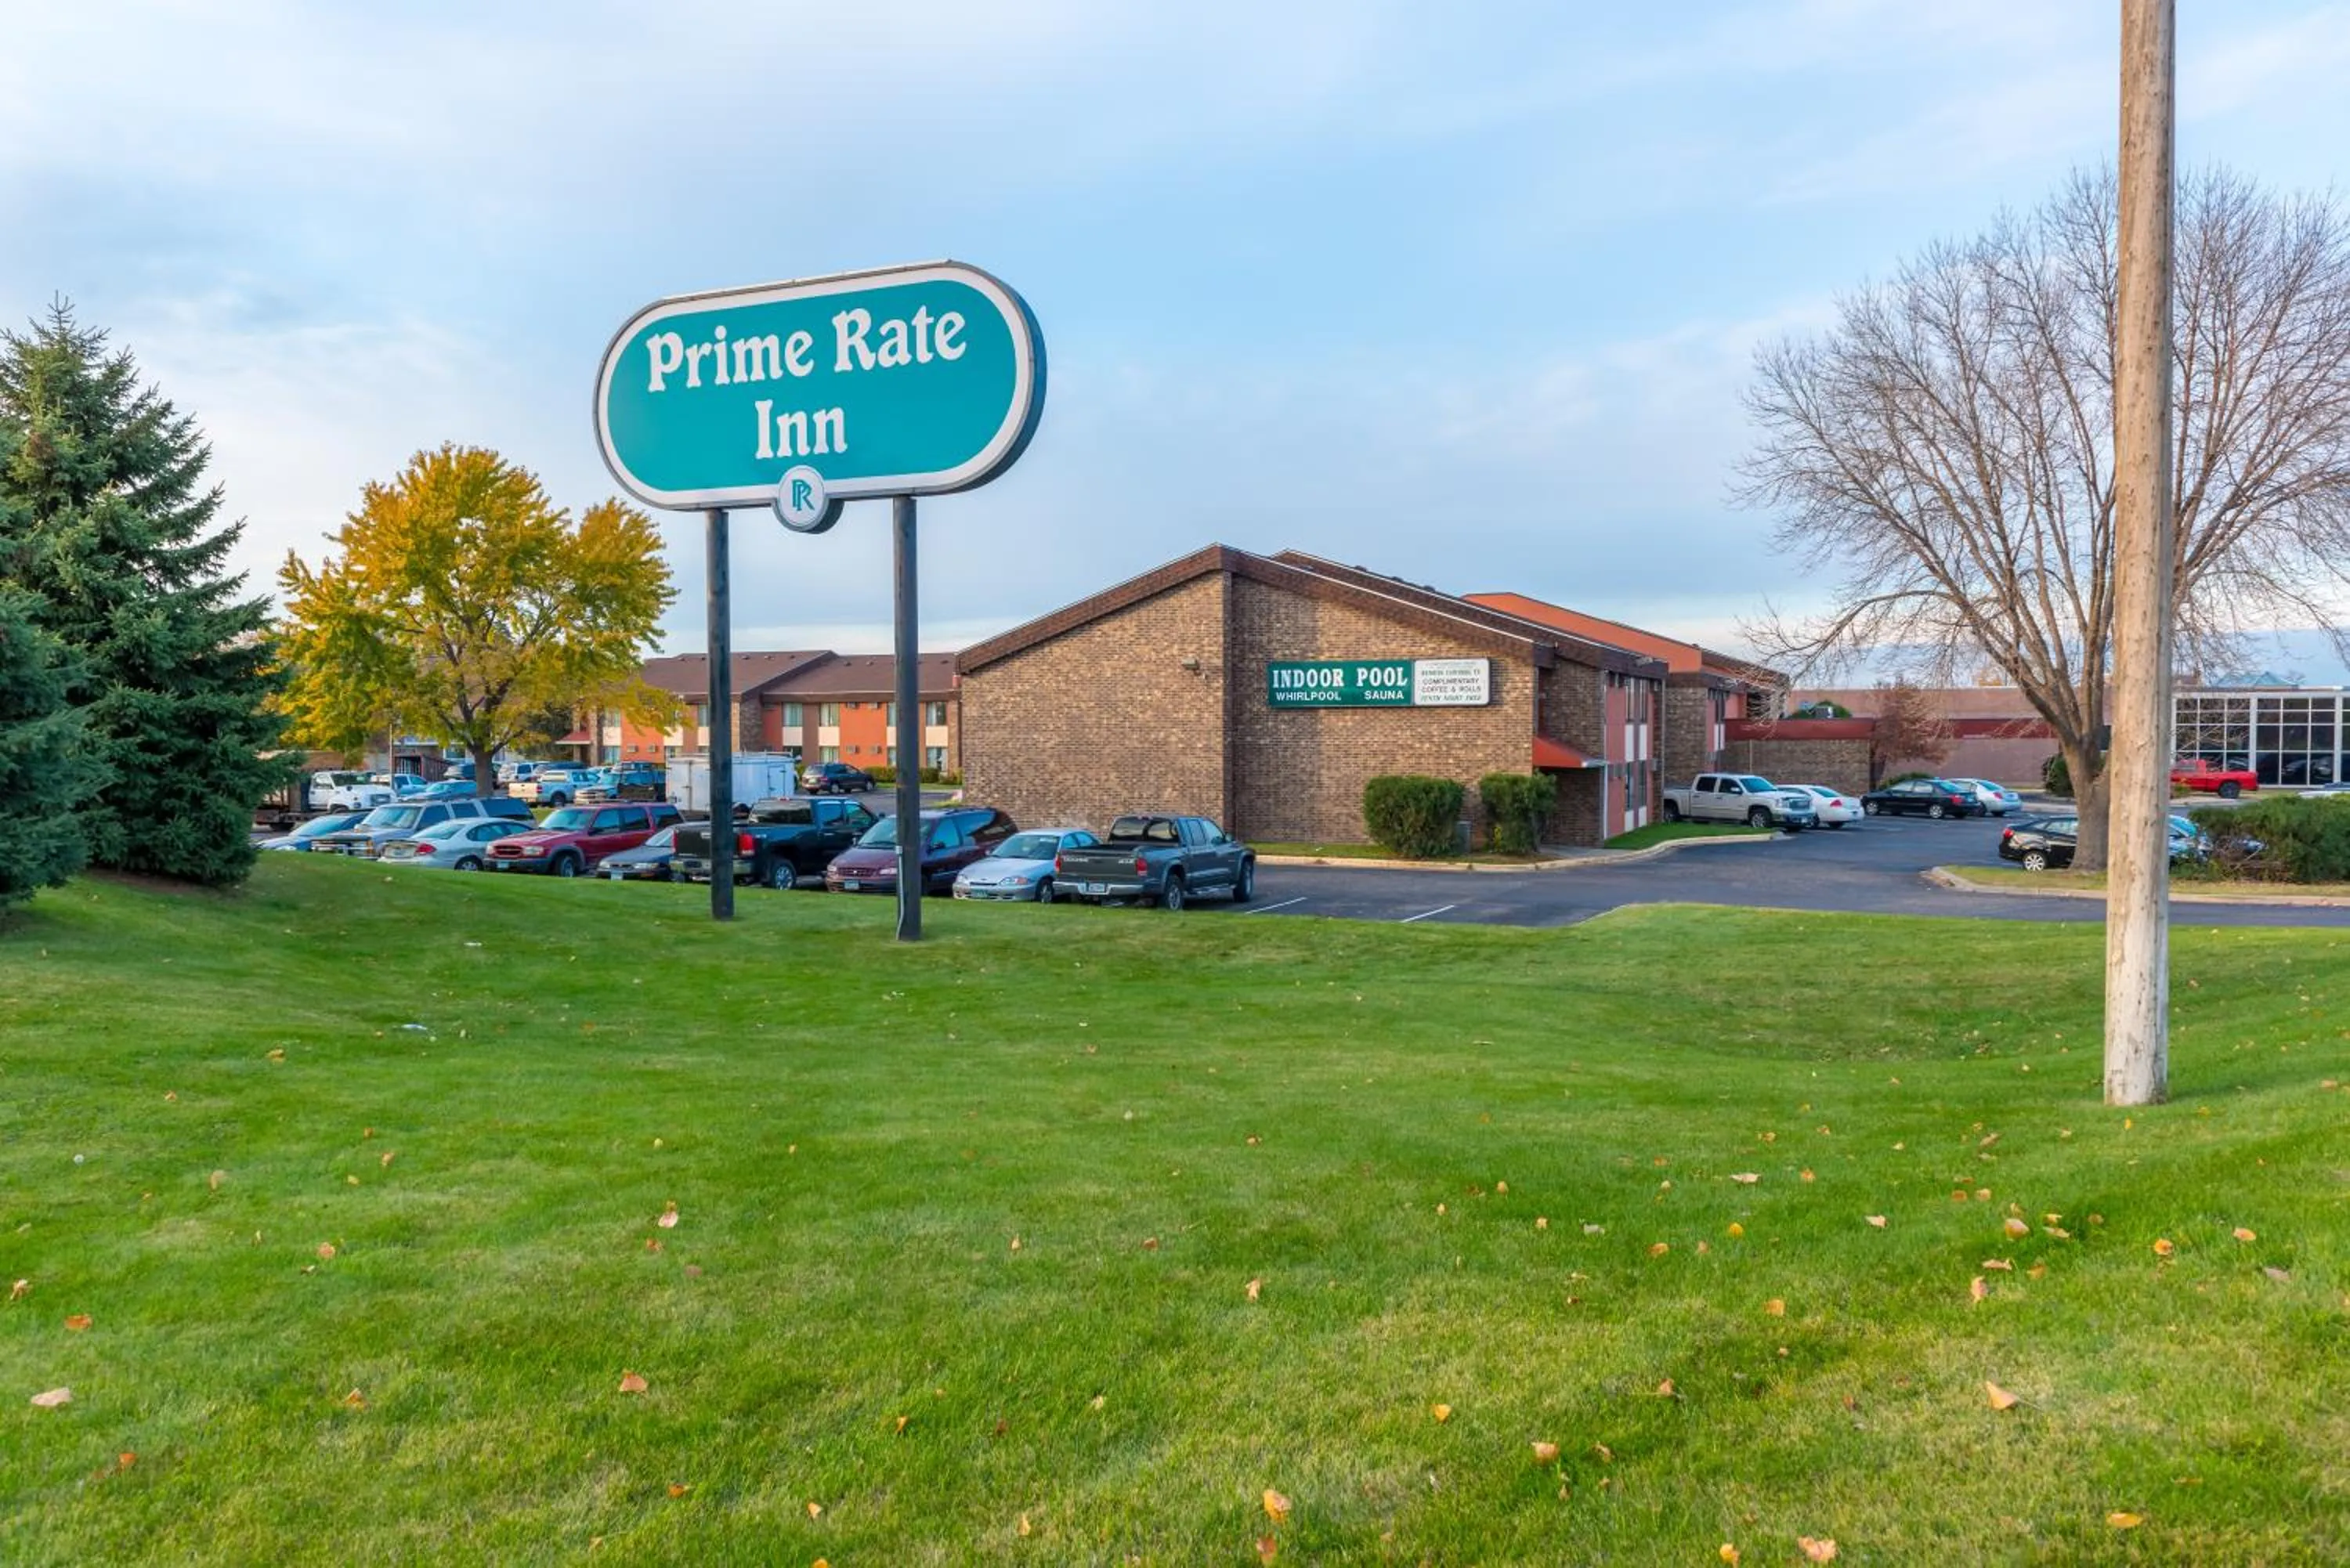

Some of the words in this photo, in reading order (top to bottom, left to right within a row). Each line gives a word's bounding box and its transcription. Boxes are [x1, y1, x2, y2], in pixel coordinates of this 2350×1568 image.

[645, 325, 814, 392] Prime
[832, 305, 967, 372] Rate
[754, 399, 848, 460] Inn
[1272, 669, 1345, 688] INDOOR
[1356, 667, 1408, 687] POOL
[1276, 691, 1342, 701] WHIRLPOOL
[1364, 690, 1405, 700] SAUNA
